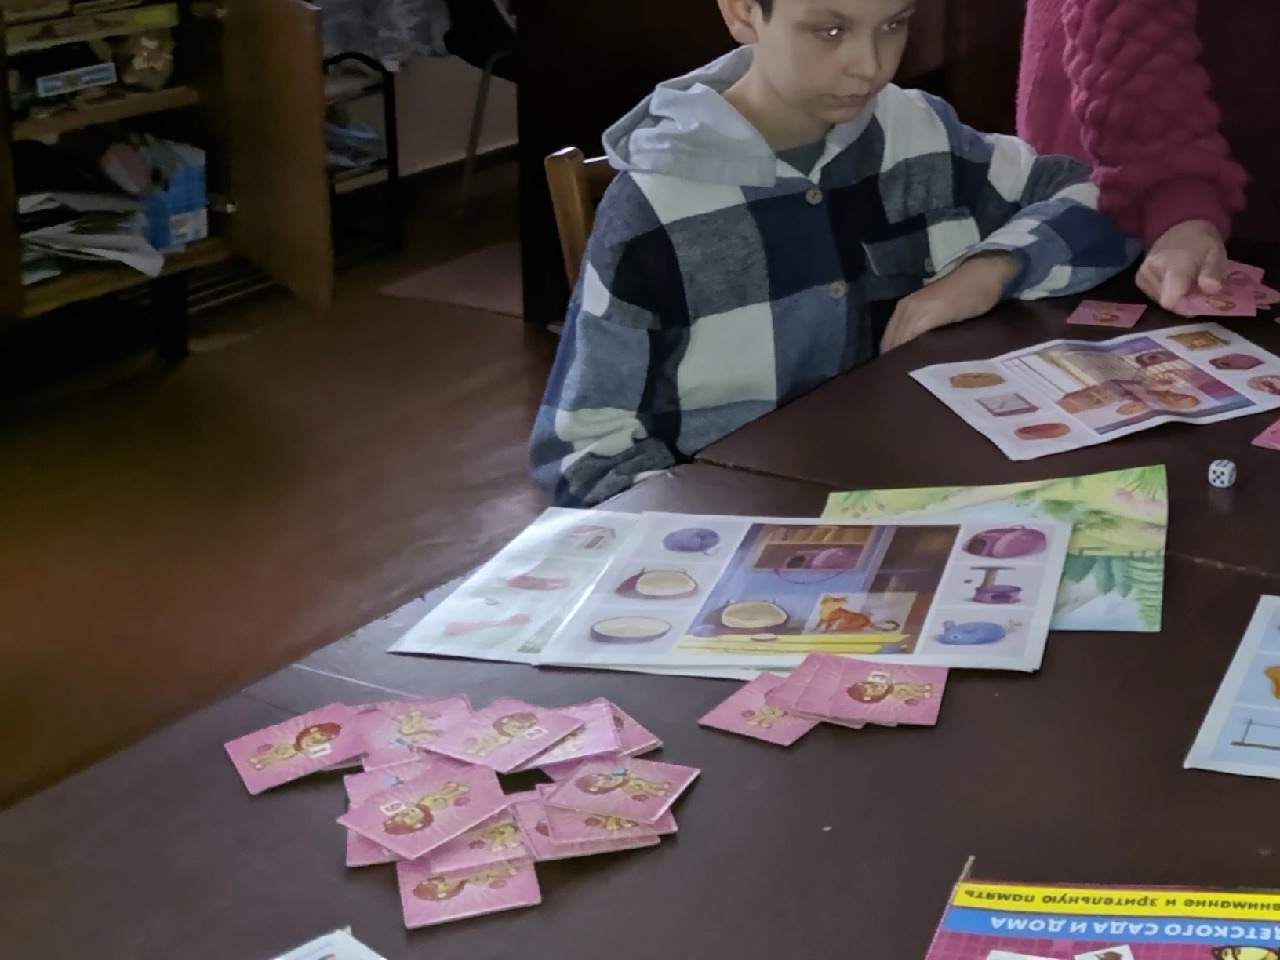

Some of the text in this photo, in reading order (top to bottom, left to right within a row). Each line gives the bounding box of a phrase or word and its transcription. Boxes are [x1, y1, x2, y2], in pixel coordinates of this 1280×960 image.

[964, 889, 1036, 903] память
[1041, 893, 1159, 907] зрительную
[1165, 898, 1177, 907] и
[989, 916, 1065, 933] ДОМА
[1069, 920, 1087, 933] И
[1092, 921, 1159, 937] САДА
